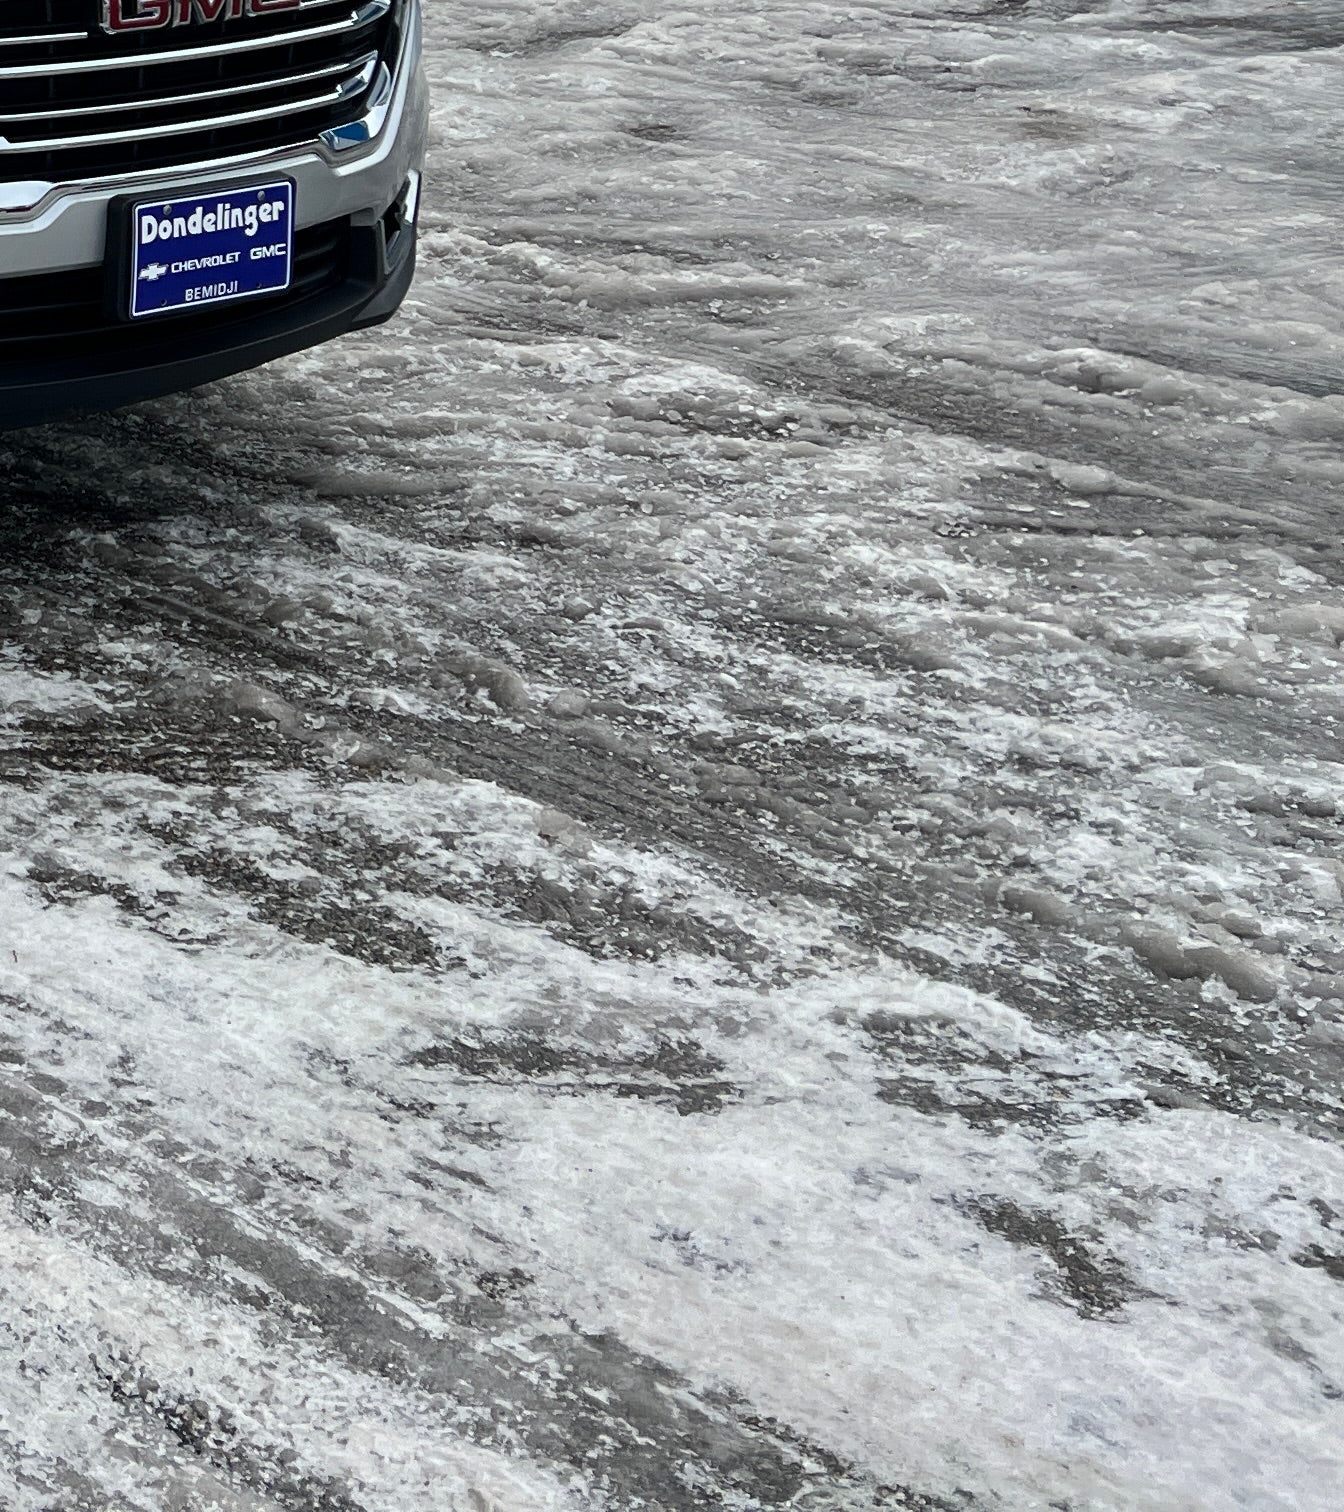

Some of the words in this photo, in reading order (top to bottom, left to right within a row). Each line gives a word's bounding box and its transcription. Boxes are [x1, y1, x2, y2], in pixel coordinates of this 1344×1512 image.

[141, 200, 285, 245] Dondelinger
[170, 251, 242, 274] CHEVROLET
[249, 243, 287, 261] GMC
[185, 280, 239, 302] BEMIDJI
